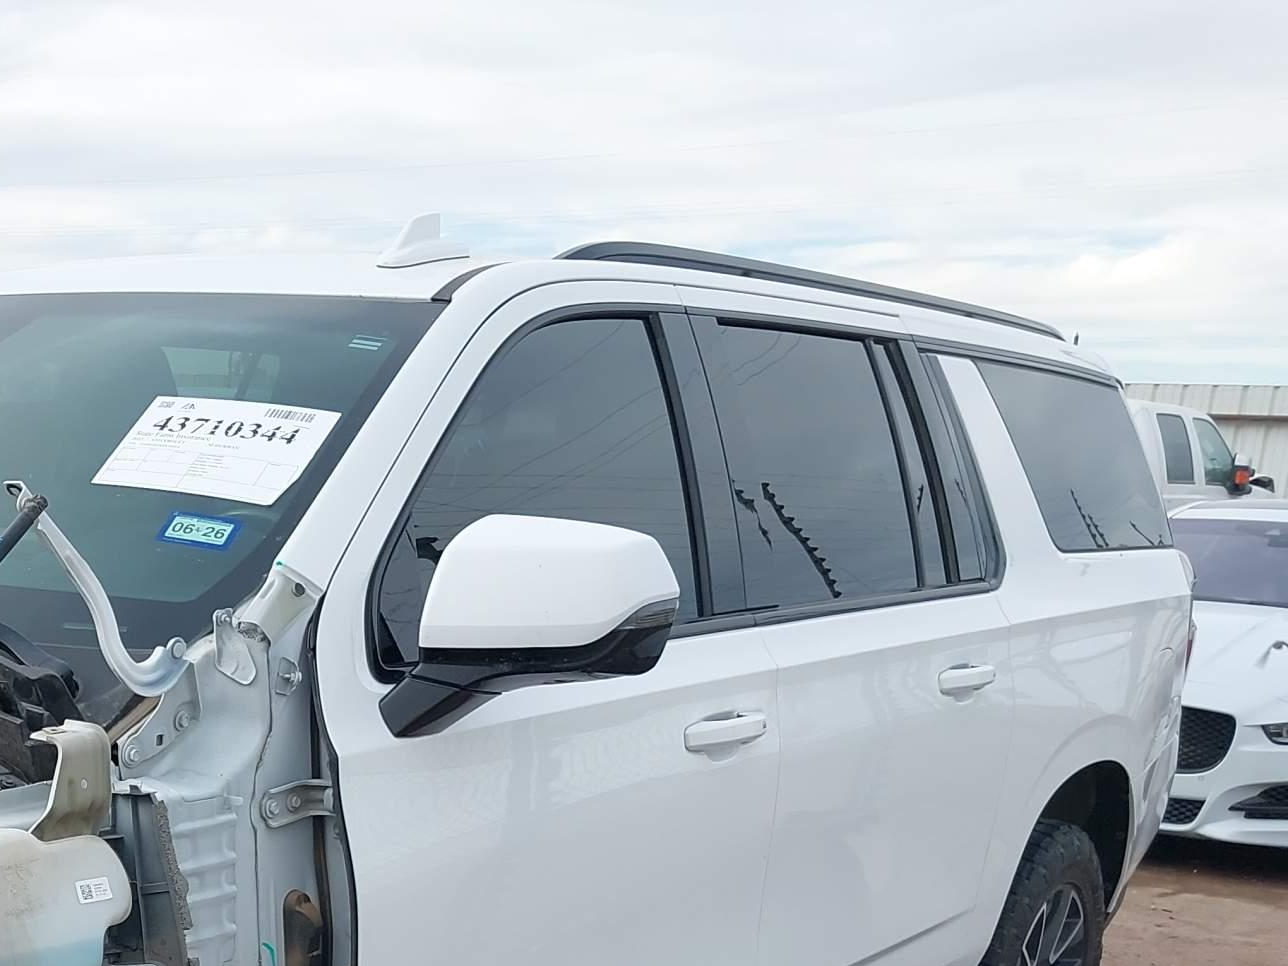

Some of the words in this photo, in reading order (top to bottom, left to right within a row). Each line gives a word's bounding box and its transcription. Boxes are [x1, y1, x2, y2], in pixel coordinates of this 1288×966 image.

[153, 415, 301, 445] 43710344
[172, 521, 196, 534] 06
[201, 526, 227, 539] 26
